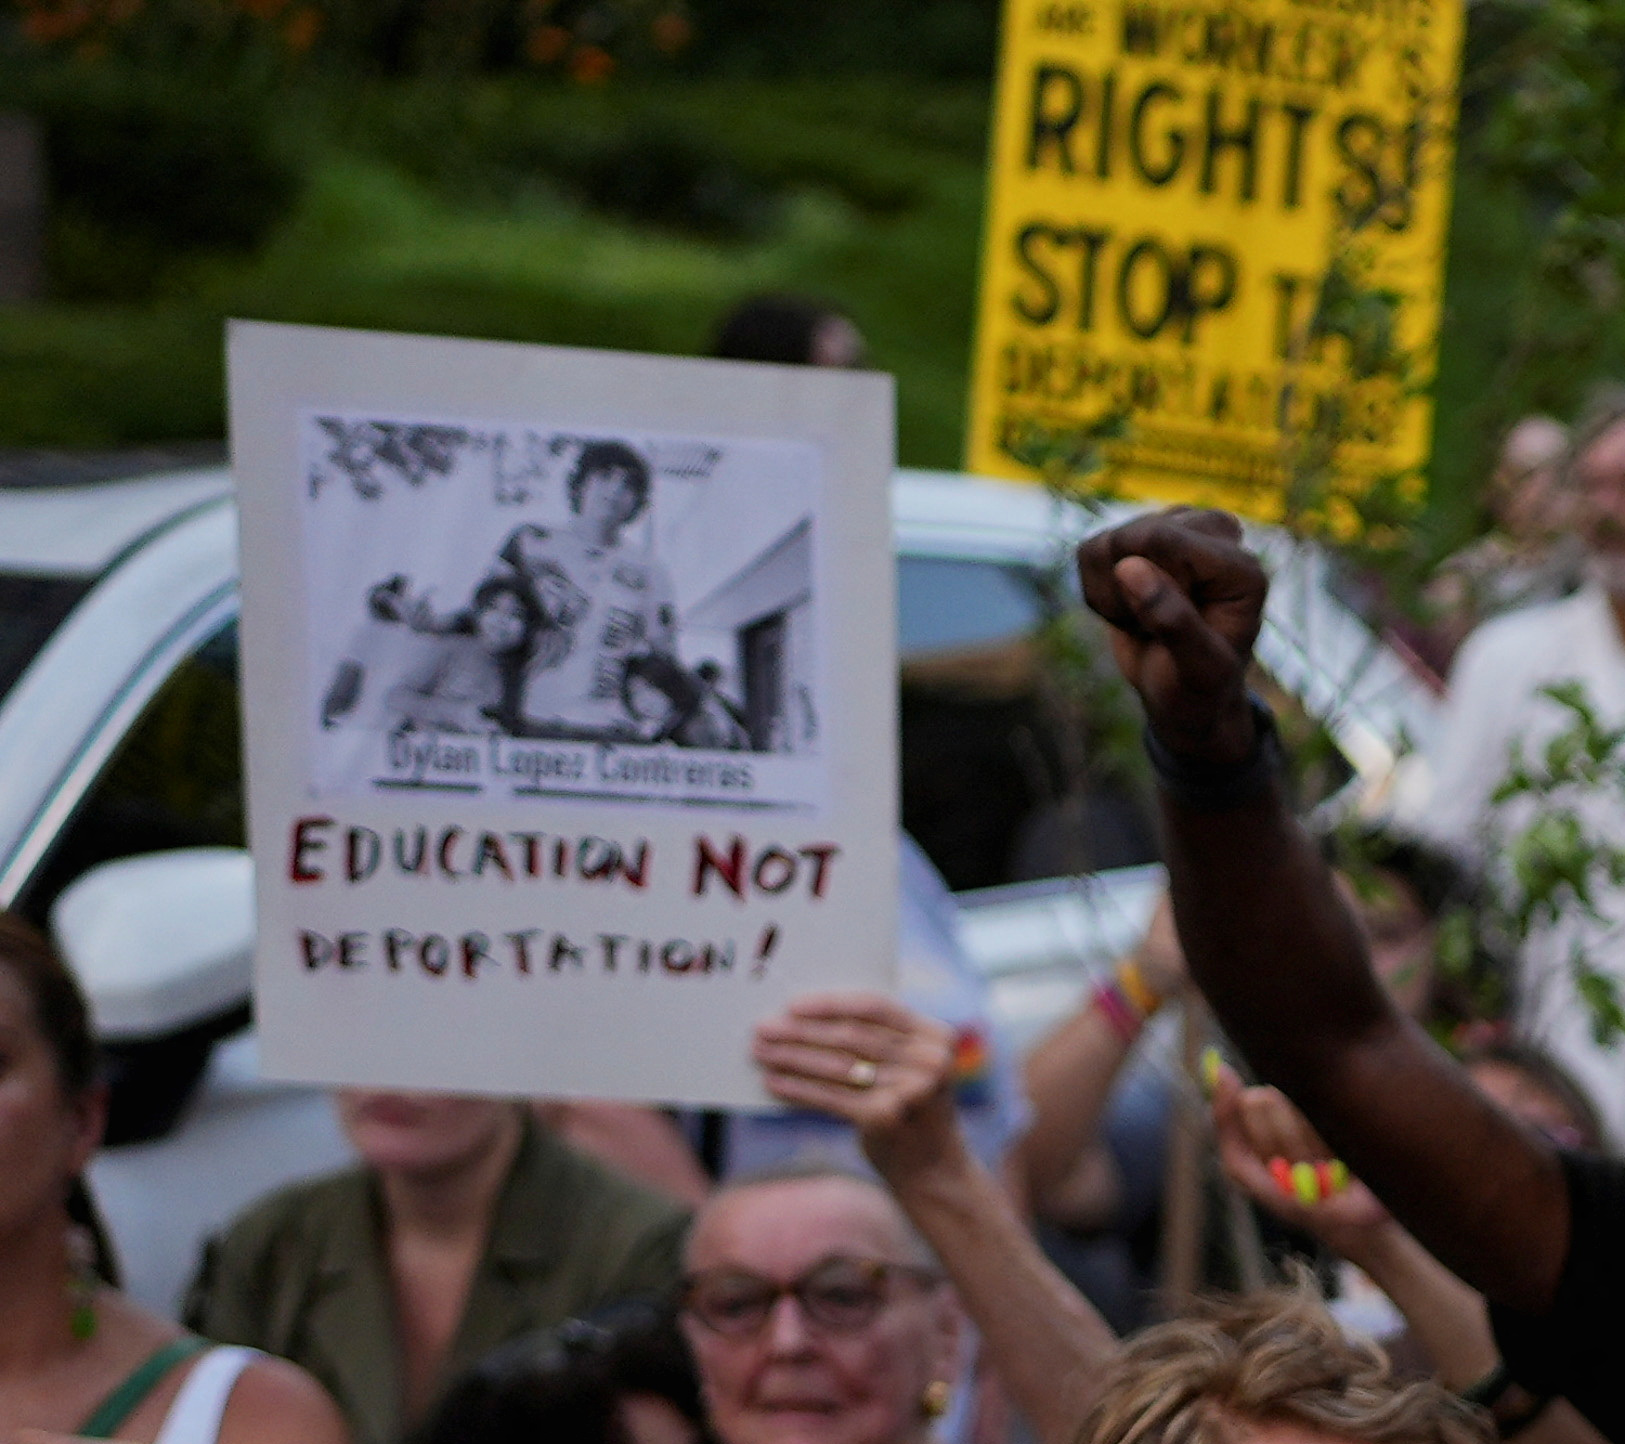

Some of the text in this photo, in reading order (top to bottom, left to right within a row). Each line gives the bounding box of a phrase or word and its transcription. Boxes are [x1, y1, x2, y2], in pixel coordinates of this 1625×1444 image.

[1011, 219, 1238, 344] STOP
[290, 814, 840, 902] EDUCATION NOT
[299, 920, 781, 984] DEPORTATION!
